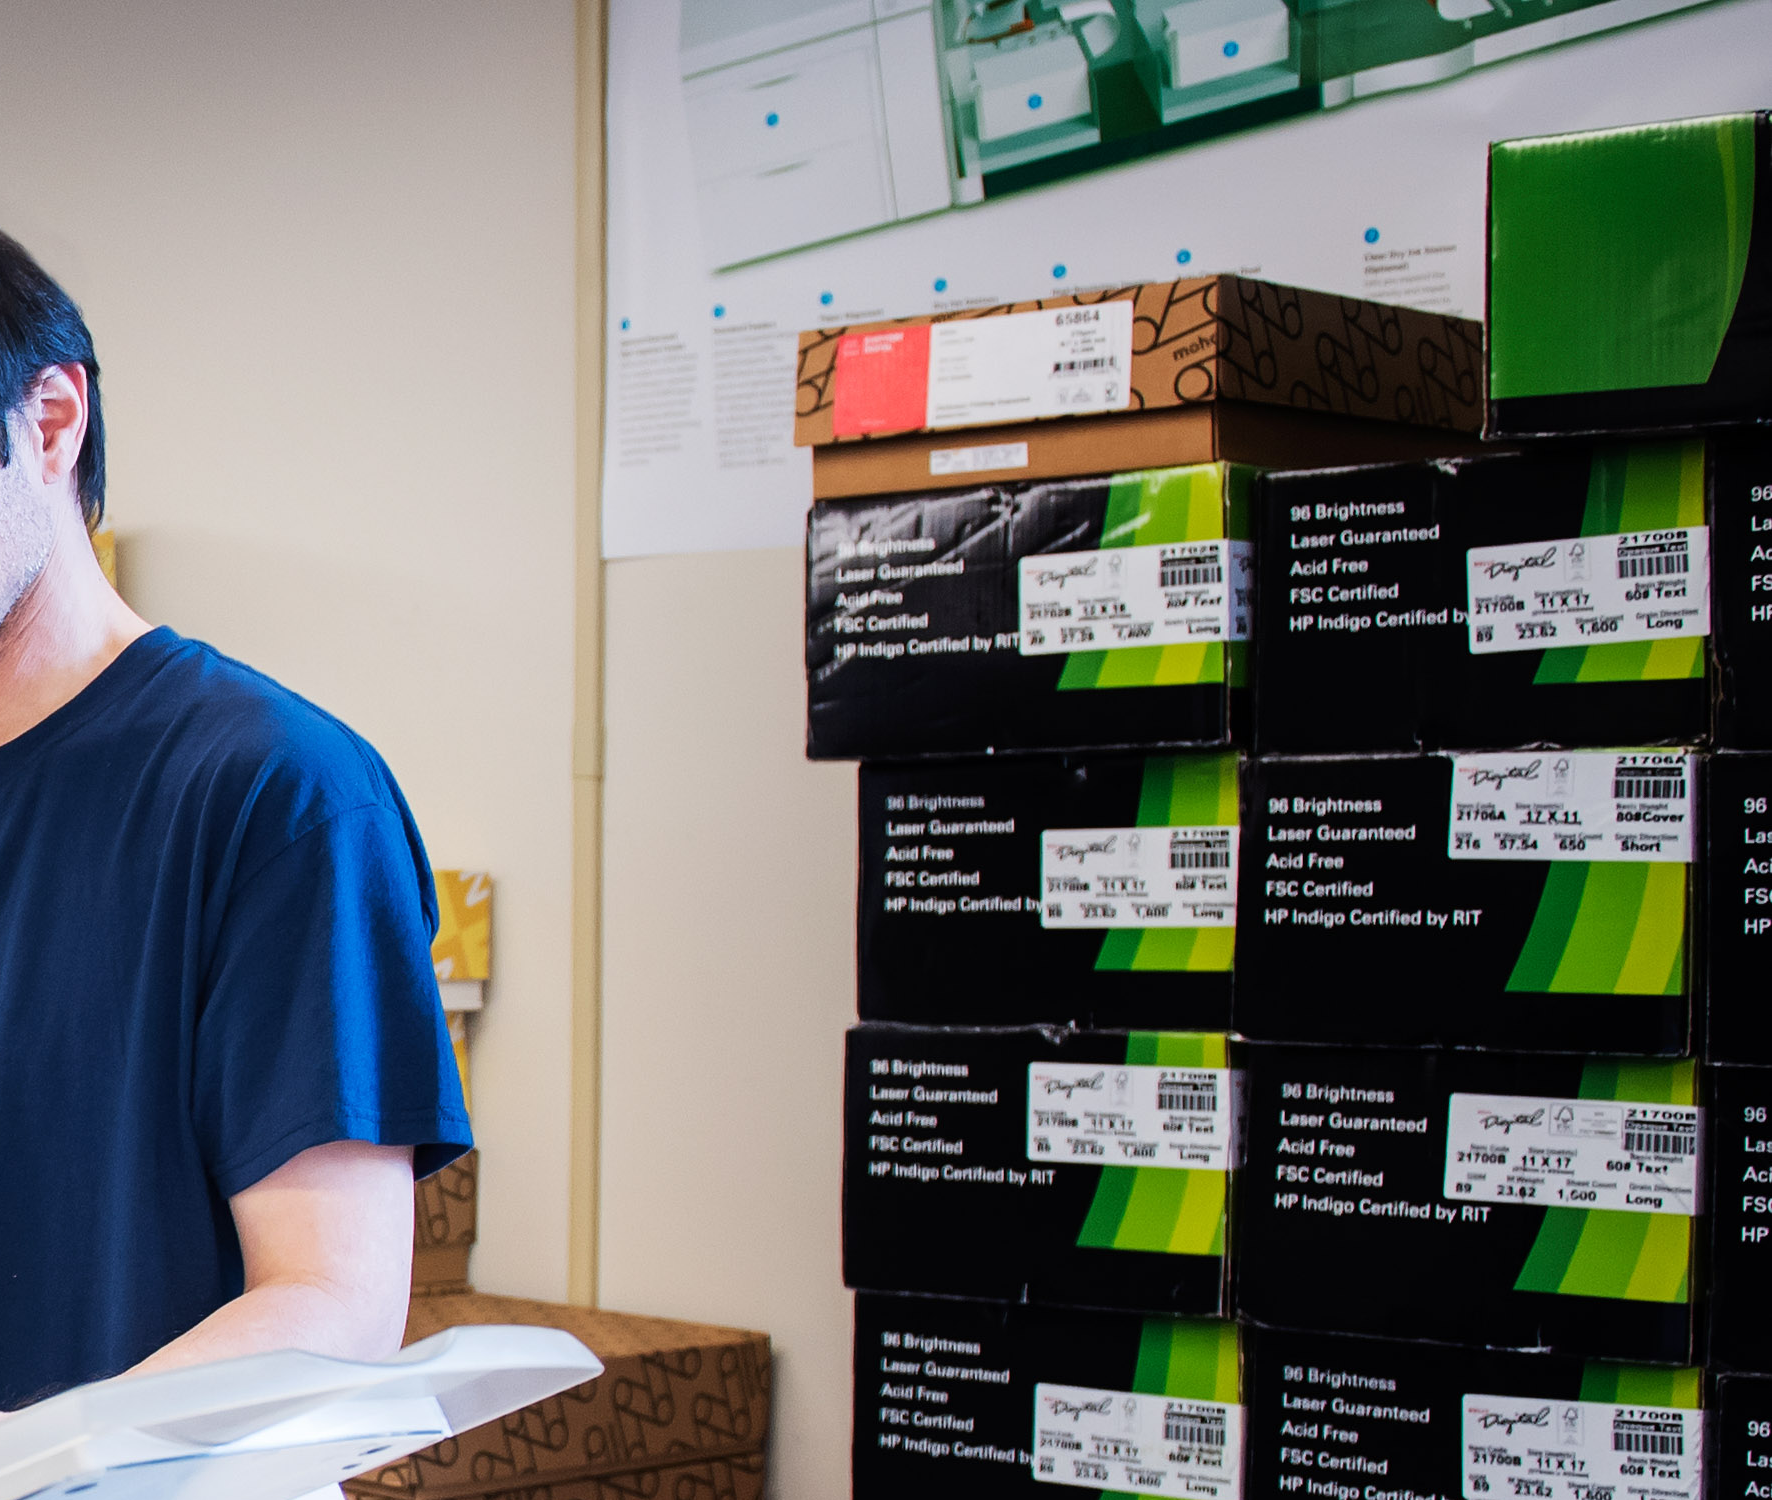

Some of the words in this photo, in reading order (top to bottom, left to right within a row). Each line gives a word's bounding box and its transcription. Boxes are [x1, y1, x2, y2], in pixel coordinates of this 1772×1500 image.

[1315, 501, 1405, 522] Brightness
[1290, 533, 1336, 550] Laser
[1339, 523, 1440, 546] Guaranteed
[1289, 559, 1328, 577] Acid
[1332, 557, 1369, 575] Free
[1484, 546, 1558, 582] Digital
[1289, 586, 1325, 605] FSC
[1328, 582, 1399, 602] Certified
[1570, 590, 1590, 607] 17
[1654, 583, 1687, 599] Text
[1289, 615, 1314, 632] HP
[1317, 613, 1372, 633] Indigo
[1375, 608, 1448, 628] Certified
[1645, 613, 1684, 630] Long
[857, 641, 905, 659] Indigo
[1468, 759, 1542, 790] Digital
[908, 794, 985, 812] Brightness
[1292, 796, 1382, 817] Brightness
[1456, 806, 1506, 821] 21706A
[1744, 798, 1768, 815] 96
[928, 818, 1015, 836] Guaranteed
[1267, 825, 1313, 842] Laser
[1316, 824, 1416, 841] Guaranteed
[1558, 836, 1590, 851] 650
[1620, 838, 1661, 853] Short
[1265, 852, 1304, 869] Acid
[1308, 852, 1344, 869] Free
[918, 870, 980, 887] Certified
[1265, 880, 1299, 898] FSC
[1302, 880, 1374, 897] Certified
[958, 895, 1022, 912] Certified
[1264, 908, 1289, 925] HP
[1292, 908, 1346, 929] Indigo
[1349, 908, 1422, 926] Certified
[1426, 909, 1449, 929] by
[1452, 909, 1483, 926] RIT
[891, 1059, 969, 1079] Brightness
[869, 1084, 910, 1101] Laser
[912, 1085, 999, 1104] Guaranteed
[1306, 1083, 1395, 1104] Brightness
[869, 1109, 903, 1127] Acid
[905, 1110, 938, 1128] Free
[1280, 1109, 1325, 1128] Laser
[1328, 1111, 1428, 1133] Guaranteed
[1480, 1108, 1545, 1134] Digital
[1744, 1107, 1767, 1122] 96
[901, 1136, 963, 1155] Certified
[1277, 1137, 1315, 1155] Acid
[1319, 1139, 1356, 1158] Free
[868, 1161, 891, 1176] HP
[894, 1162, 940, 1182] Indigo
[942, 1164, 1005, 1183] Certified
[1008, 1168, 1027, 1187] by
[1030, 1168, 1055, 1185] RIT
[1519, 1155, 1539, 1172] 11
[1541, 1156, 1550, 1167] X
[1556, 1156, 1572, 1169] 17
[1636, 1161, 1668, 1174] Text
[1276, 1164, 1310, 1183] FSC
[1313, 1167, 1384, 1187] Certified
[1274, 1192, 1299, 1209] HP
[1302, 1194, 1355, 1216] Indigo
[1358, 1198, 1431, 1219] Certified
[1435, 1203, 1457, 1224] by
[1461, 1205, 1491, 1223] RIT
[1625, 1193, 1663, 1209] Long
[1741, 1226, 1769, 1242] HP
[924, 1360, 1010, 1384] Guaranteed
[1283, 1365, 1304, 1382] 96
[1308, 1367, 1396, 1392] Brightness
[1282, 1392, 1327, 1412] Laser
[1331, 1397, 1430, 1424] Guaranteed
[912, 1411, 974, 1432] Certified
[1281, 1419, 1319, 1439] Acid
[1322, 1424, 1359, 1444] Free
[1479, 1407, 1550, 1435] Digital
[1748, 1421, 1771, 1437] 96
[904, 1436, 950, 1457] Indigo
[953, 1441, 1016, 1463] Certified
[1280, 1446, 1314, 1466] FSC
[1317, 1451, 1388, 1475] Certified
[1536, 1454, 1551, 1469] 11
[1556, 1459, 1565, 1470] X
[1570, 1458, 1586, 1472] 17
[1649, 1465, 1681, 1480] Text
[1279, 1474, 1304, 1492] HP
